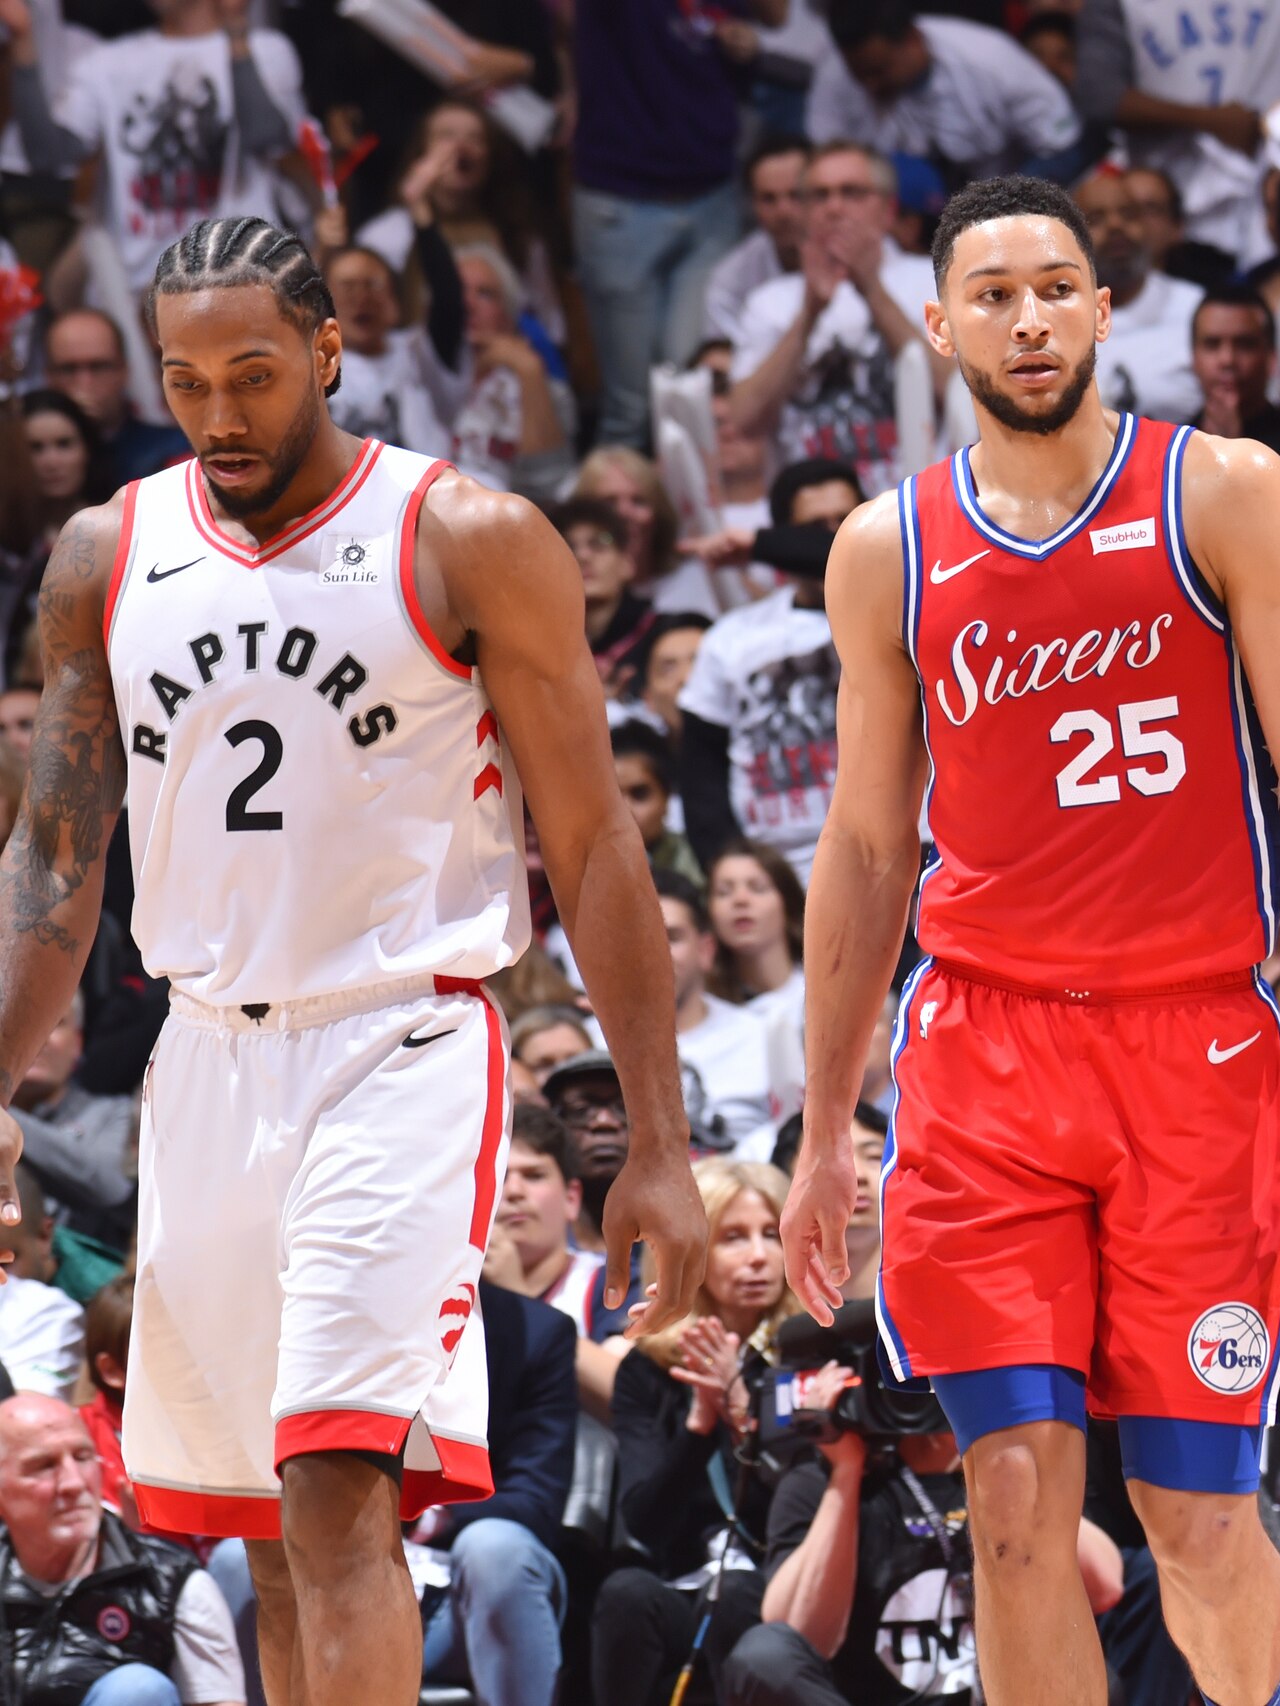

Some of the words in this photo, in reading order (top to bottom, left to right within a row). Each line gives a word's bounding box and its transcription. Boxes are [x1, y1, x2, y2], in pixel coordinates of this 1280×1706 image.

[323, 571, 349, 583] Sun
[352, 571, 379, 583] Life
[1099, 528, 1148, 546] StubHub
[132, 621, 400, 767] RAPTORS
[935, 613, 1173, 727] Sixers
[223, 719, 284, 832] 2
[1050, 695, 1187, 808] 25
[1200, 1337, 1263, 1370] 76ers
